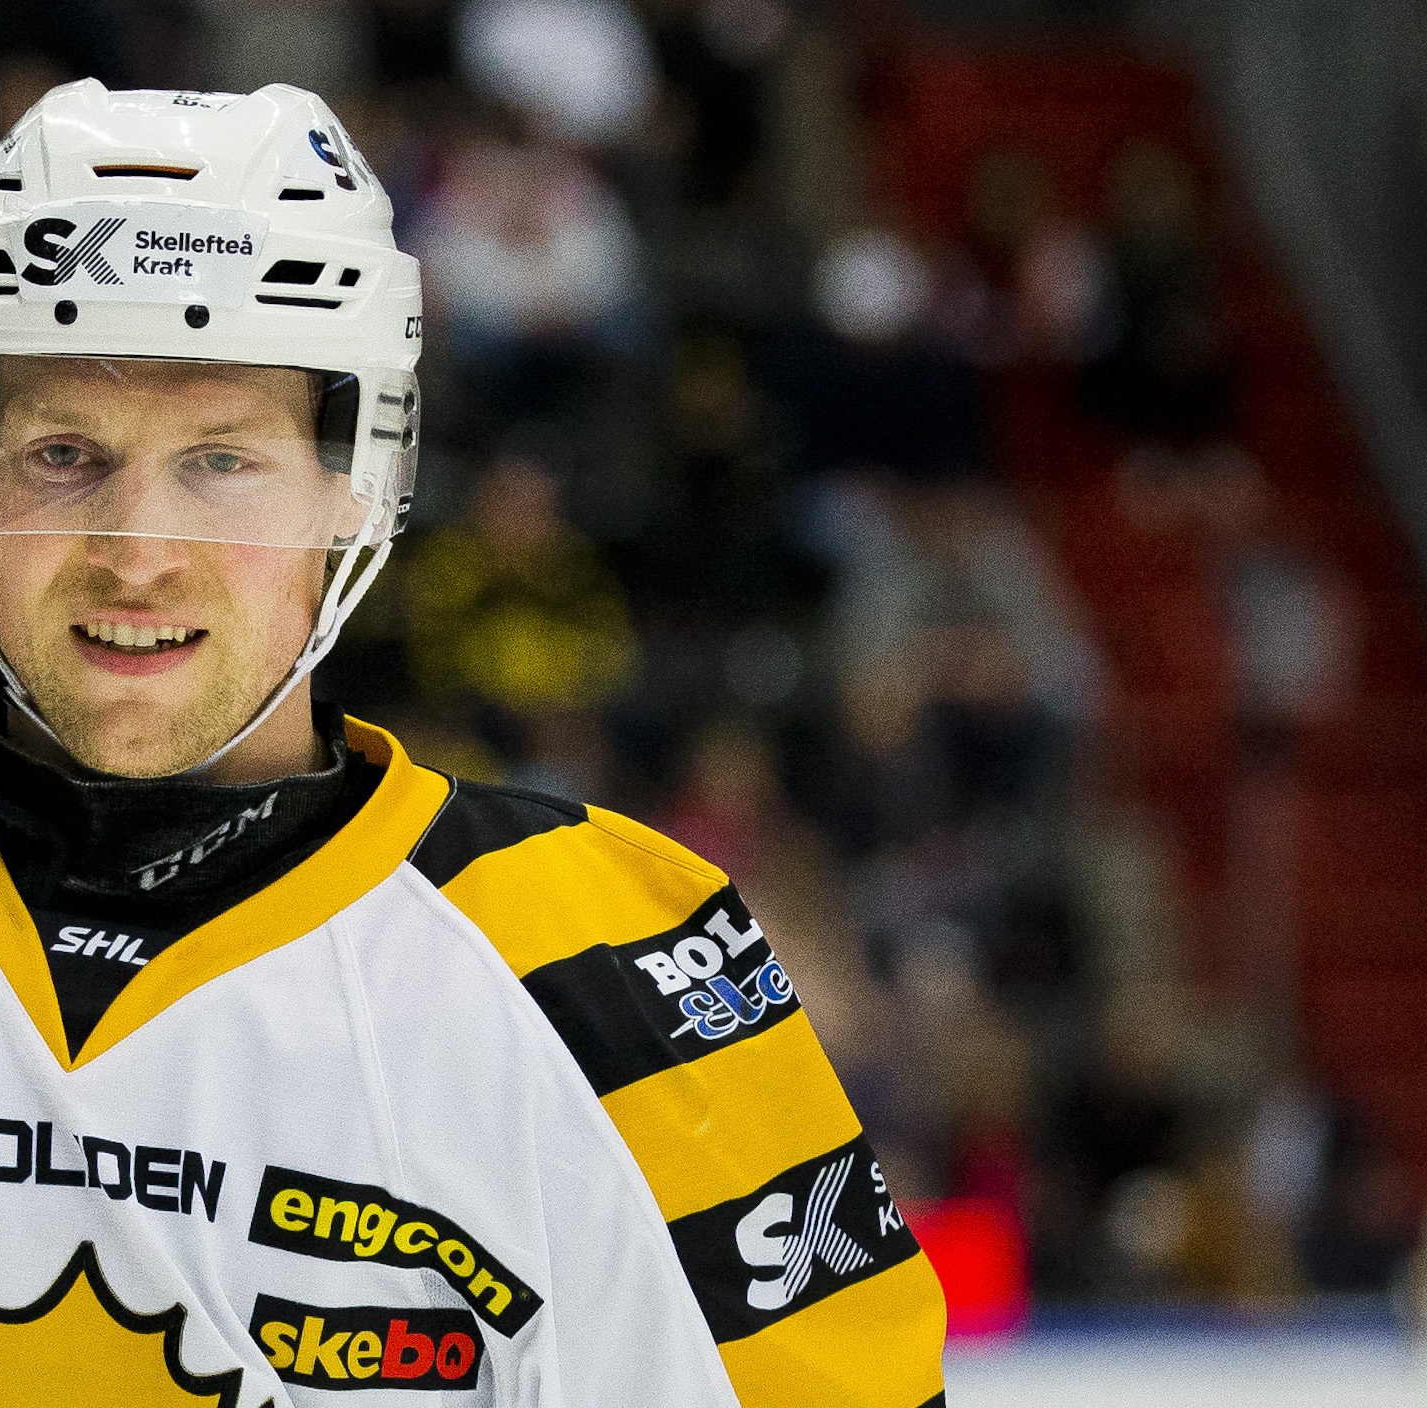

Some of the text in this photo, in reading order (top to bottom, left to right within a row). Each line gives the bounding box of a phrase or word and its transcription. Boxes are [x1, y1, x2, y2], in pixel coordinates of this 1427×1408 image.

[132, 255, 194, 278] Kraft
[134, 230, 254, 257] Skellefteå
[130, 791, 280, 892] CCM
[49, 925, 150, 967] SHL
[269, 1188, 513, 1317] engcon
[259, 1315, 476, 1381] skebo
